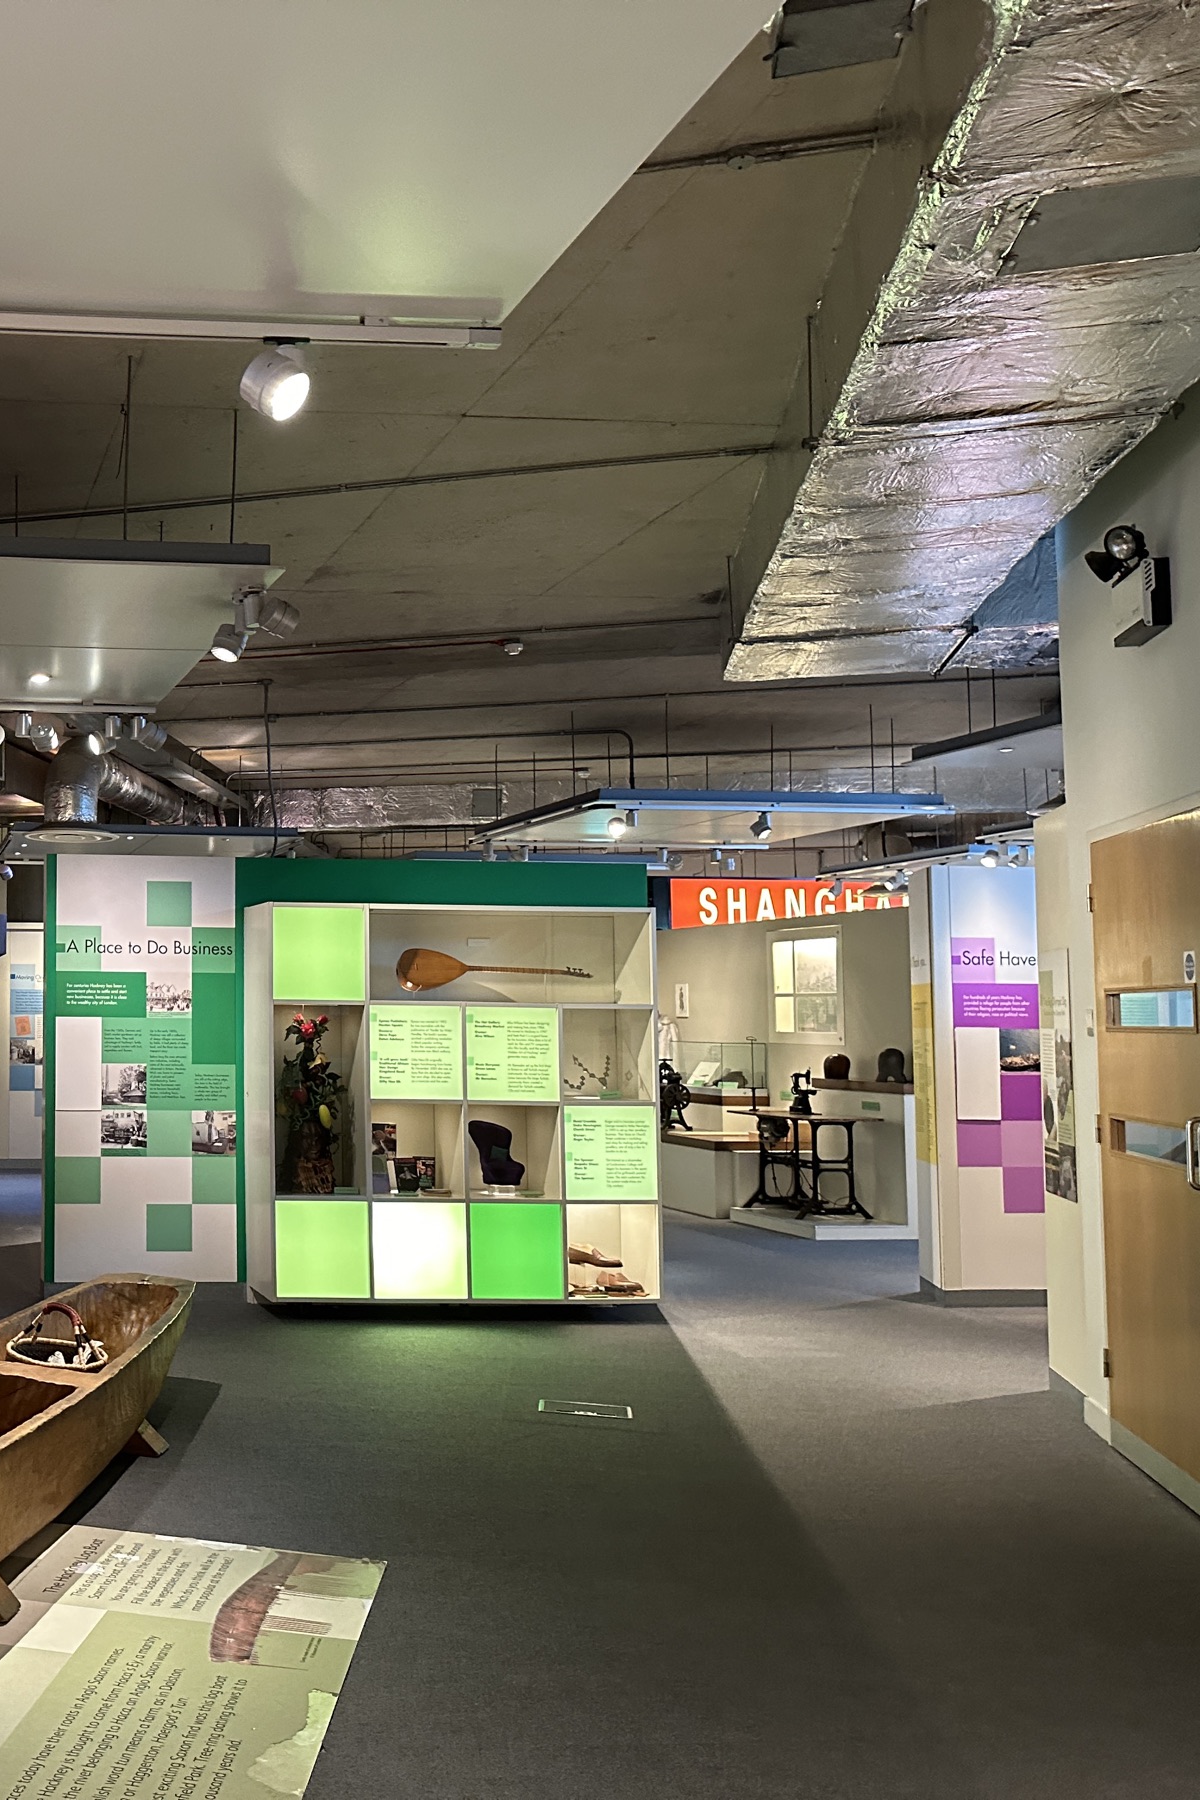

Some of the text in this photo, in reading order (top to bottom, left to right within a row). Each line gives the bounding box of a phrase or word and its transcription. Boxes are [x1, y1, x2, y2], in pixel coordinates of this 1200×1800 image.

[66, 938, 233, 955] A Place to Do Business
[962, 949, 994, 965] Safe
[42, 1539, 104, 1593] The Hackney Log Boat
[145, 1576, 161, 1590] basket
[161, 1556, 177, 1565] boat
[172, 1548, 182, 1556] with
[110, 1593, 125, 1601] You
[125, 1574, 143, 1586] going
[139, 1636, 161, 1654] marshy
[156, 1643, 174, 1661] warrior.
[126, 1660, 144, 1668] Ey,
[140, 1662, 160, 1679] Saxon
[114, 1668, 136, 1687] Haca's
[210, 1676, 227, 1689] boat
[102, 1688, 120, 1702] from
[130, 1680, 150, 1697] Anglo
[204, 1690, 223, 1699] log
[126, 1698, 138, 1706] an
[199, 1700, 215, 1711] this
[223, 1692, 241, 1710] shows
[18, 1762, 45, 1783] today
[32, 1744, 55, 1761] have
[47, 1727, 66, 1743] their
[61, 1711, 79, 1727] roots
[76, 1686, 97, 1703] Anglo
[88, 1667, 110, 1684] Saxon
[104, 1648, 124, 1666] names.
[93, 1703, 112, 1720] come
[111, 1707, 134, 1725] Haca,
[195, 1713, 208, 1725] was
[85, 1721, 99, 1729] to
[152, 1711, 181, 1743] Haergod's
[212, 1711, 235, 1732] dating
[93, 1786, 112, 1800] lish
[106, 1766, 124, 1784] word
[115, 1753, 132, 1766] tun
[125, 1730, 146, 1752] means
[139, 1708, 162, 1723] farm,
[159, 1669, 185, 1691] Dalston,
[182, 1726, 201, 1739] find
[66, 1730, 94, 1757] thought
[83, 1734, 118, 1768] belonging
[170, 1740, 192, 1761] Saxon
[193, 1734, 224, 1762] Tree-ring
[226, 1740, 242, 1751] old.
[126, 1746, 162, 1787] Haggerston,
[219, 1753, 236, 1771] years
[38, 1765, 73, 1796] Hackney
[74, 1769, 92, 1785] river
[158, 1763, 185, 1791] exciting
[63, 1786, 81, 1799] the
[124, 1788, 136, 1797] or
